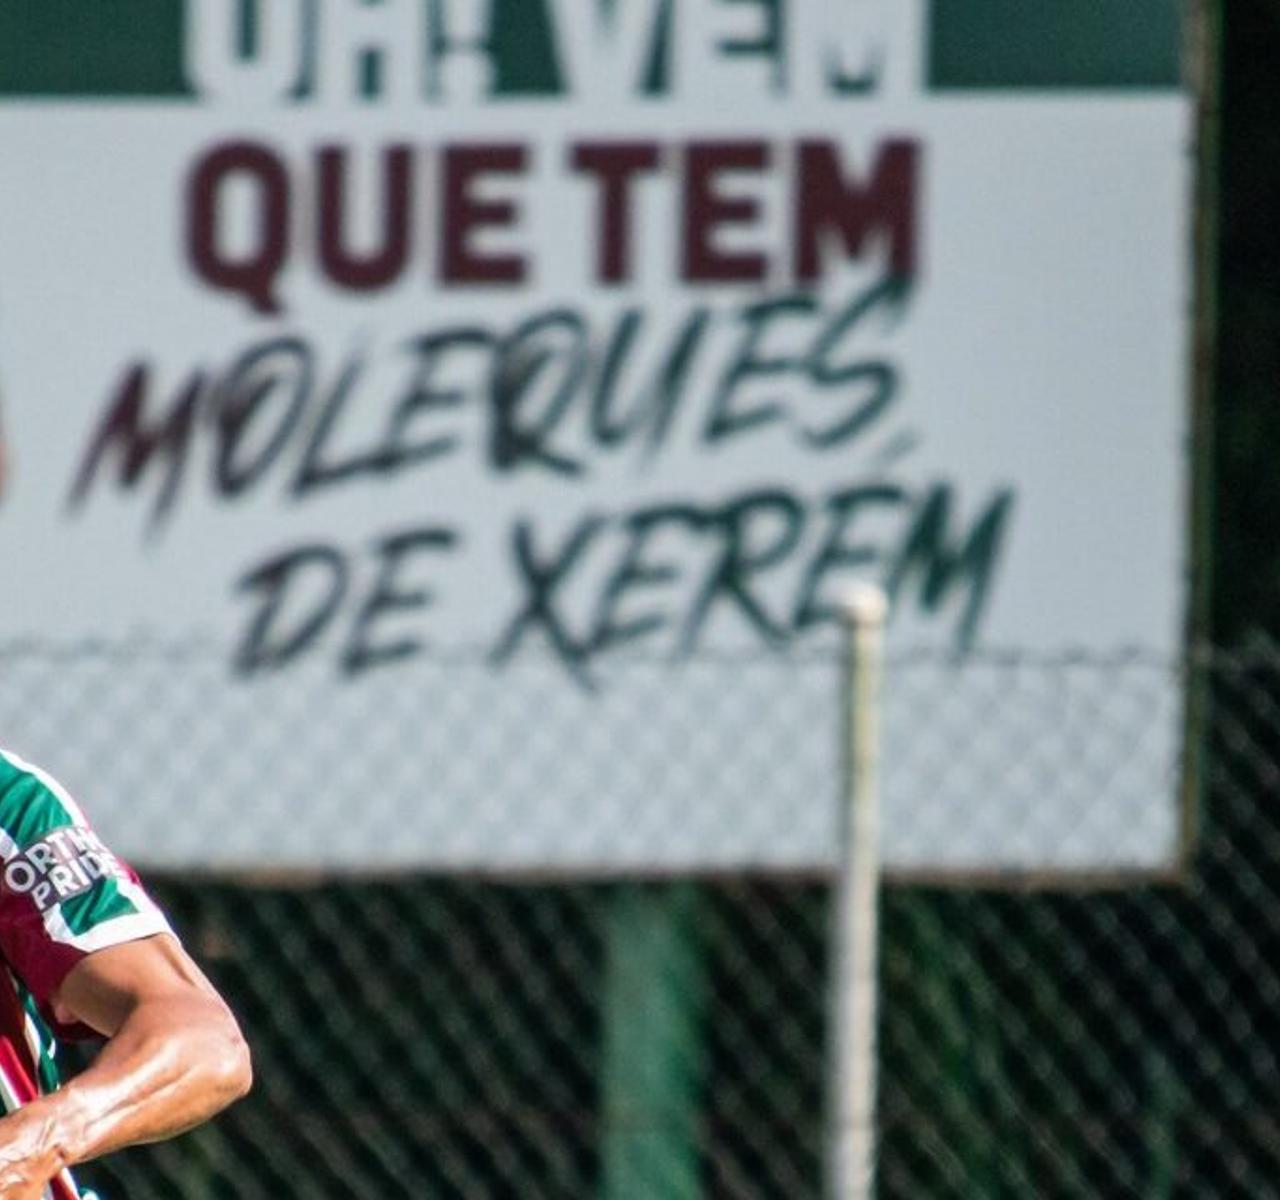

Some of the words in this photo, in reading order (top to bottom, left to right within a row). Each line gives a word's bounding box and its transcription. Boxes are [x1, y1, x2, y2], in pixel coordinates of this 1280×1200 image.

[181, 139, 535, 316] QUE
[566, 138, 926, 288] TEM
[64, 272, 916, 544] MOLEQUES
[232, 528, 458, 677] DE
